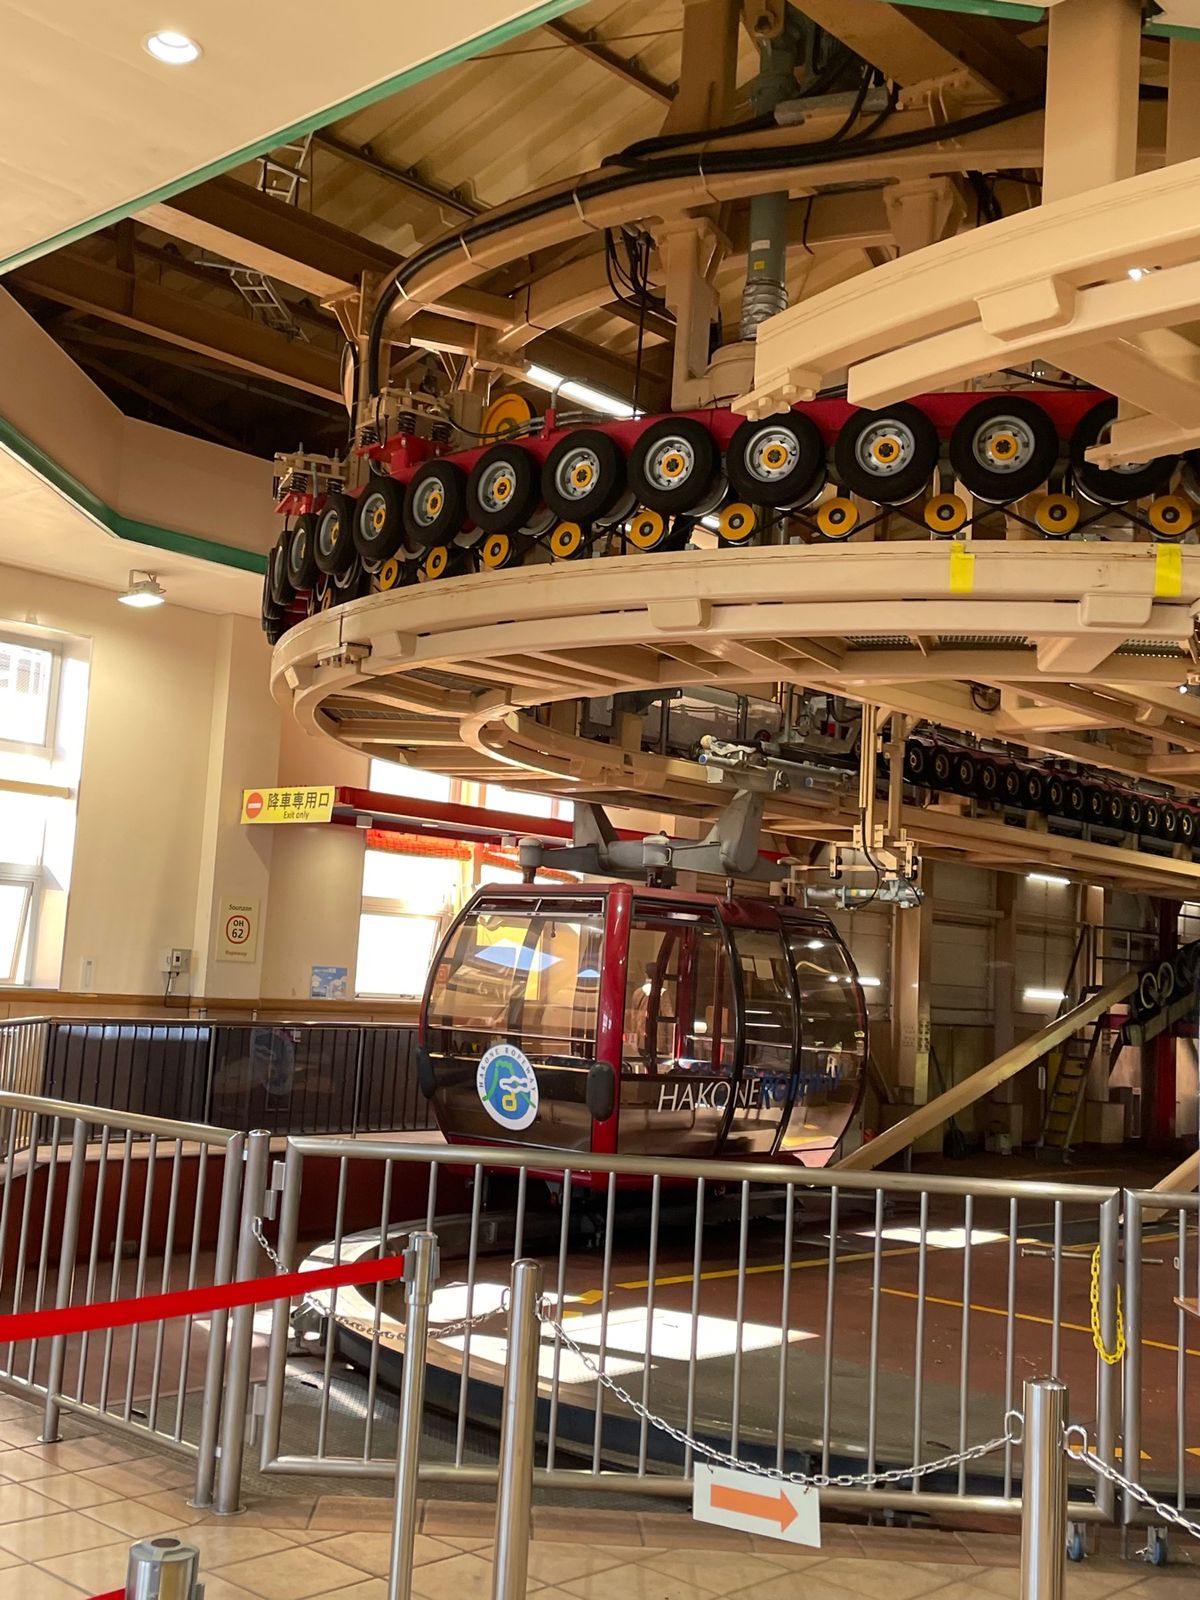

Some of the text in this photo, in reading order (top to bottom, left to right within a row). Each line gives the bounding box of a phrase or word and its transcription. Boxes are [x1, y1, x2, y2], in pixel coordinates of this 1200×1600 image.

[267, 792, 330, 811] 降車専用口
[283, 811, 310, 820] Exit only
[233, 919, 244, 927] OH
[232, 929, 244, 939] 62
[479, 1048, 536, 1091] HAKONE ROPEWAY
[657, 1077, 761, 1113] HAKONE
